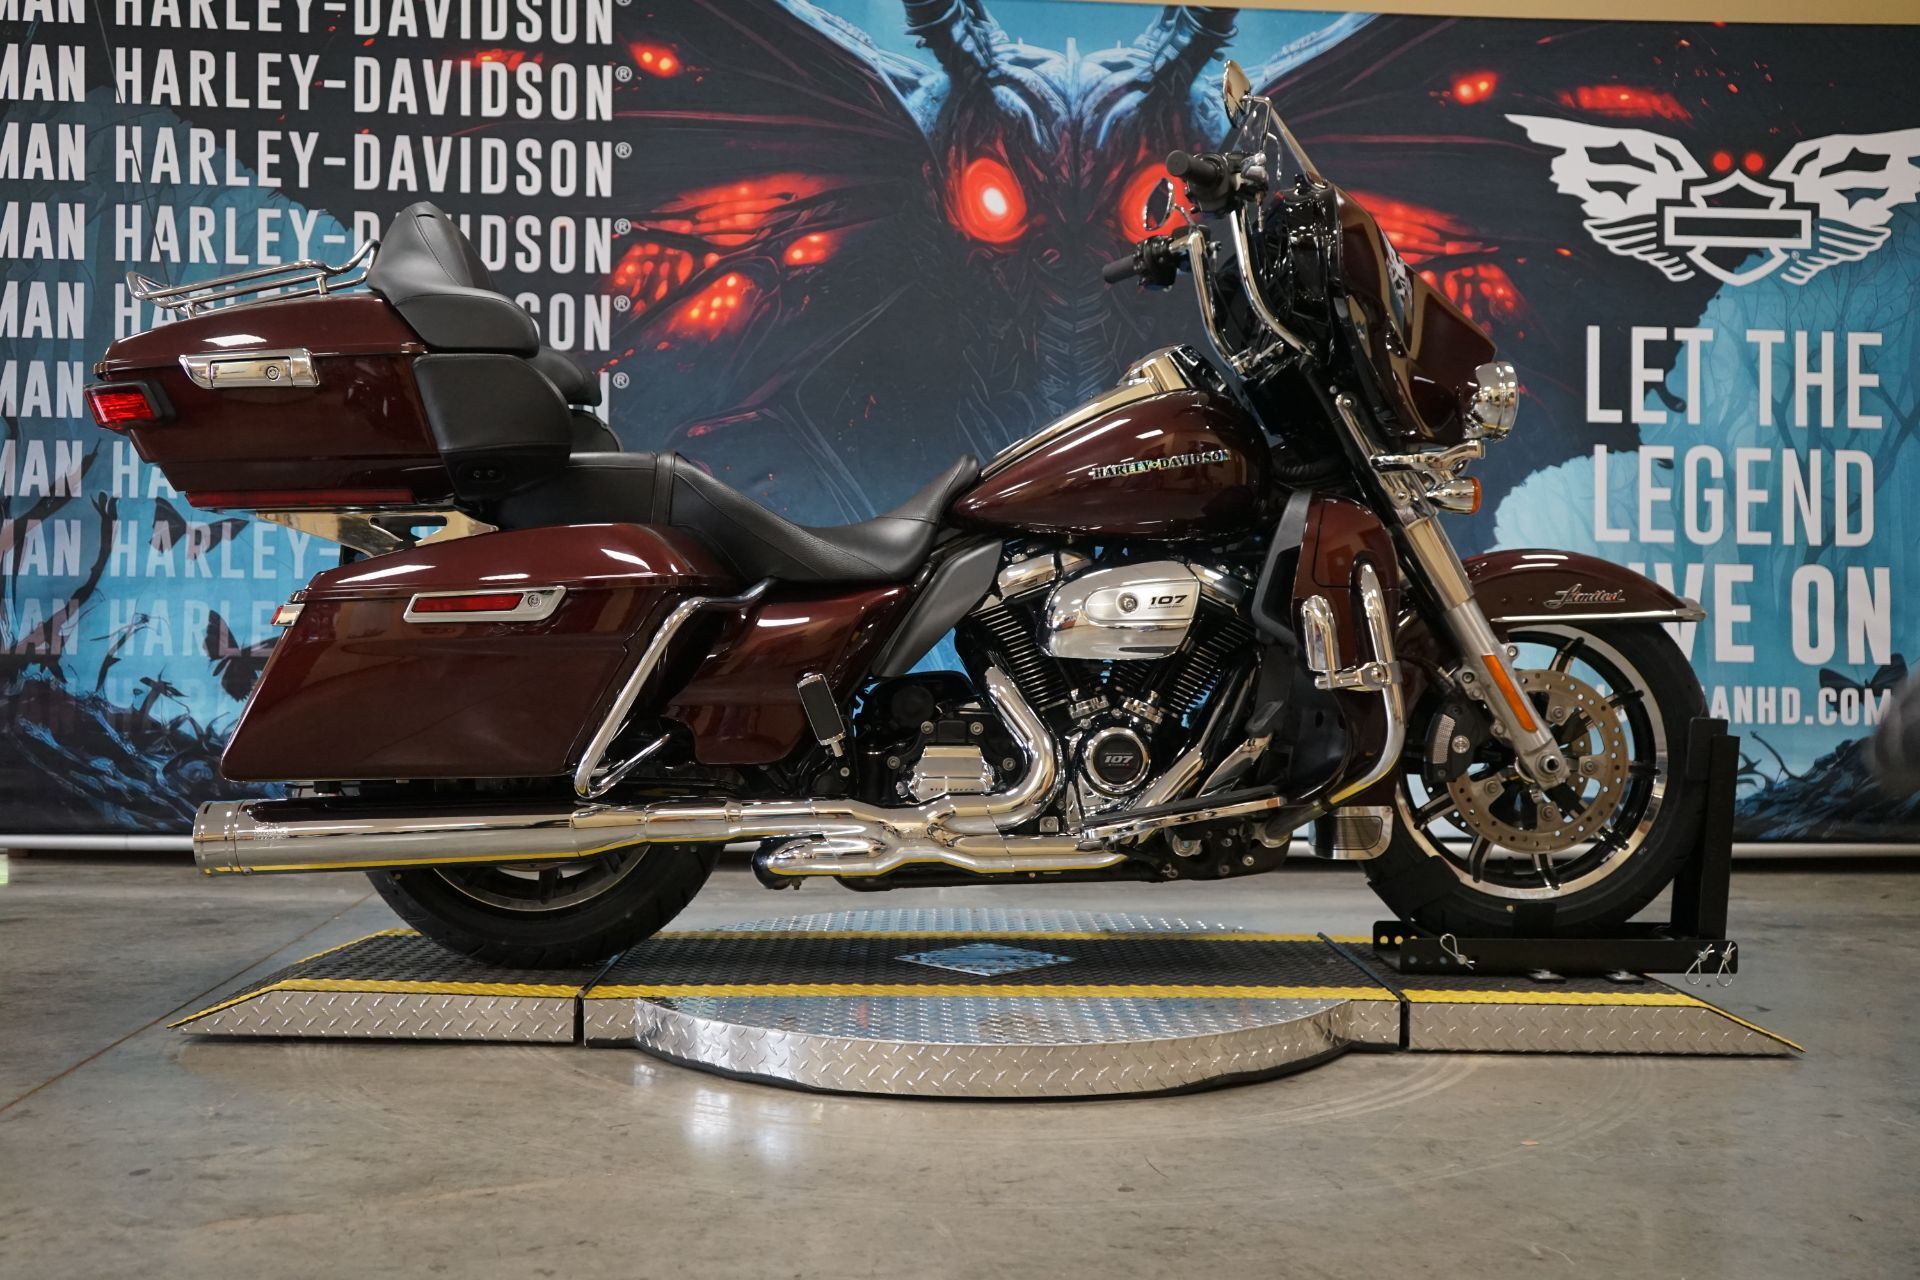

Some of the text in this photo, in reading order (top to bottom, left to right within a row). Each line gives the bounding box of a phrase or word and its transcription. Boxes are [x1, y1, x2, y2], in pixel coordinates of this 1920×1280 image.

[1586, 325, 1883, 429] LET THE
[1593, 444, 1874, 547] LEGEND
[1151, 595, 1188, 605] 107
[1791, 565, 1891, 666] ON
[1702, 685, 1893, 727] ANHD.COM
[1104, 755, 1134, 764] 107
